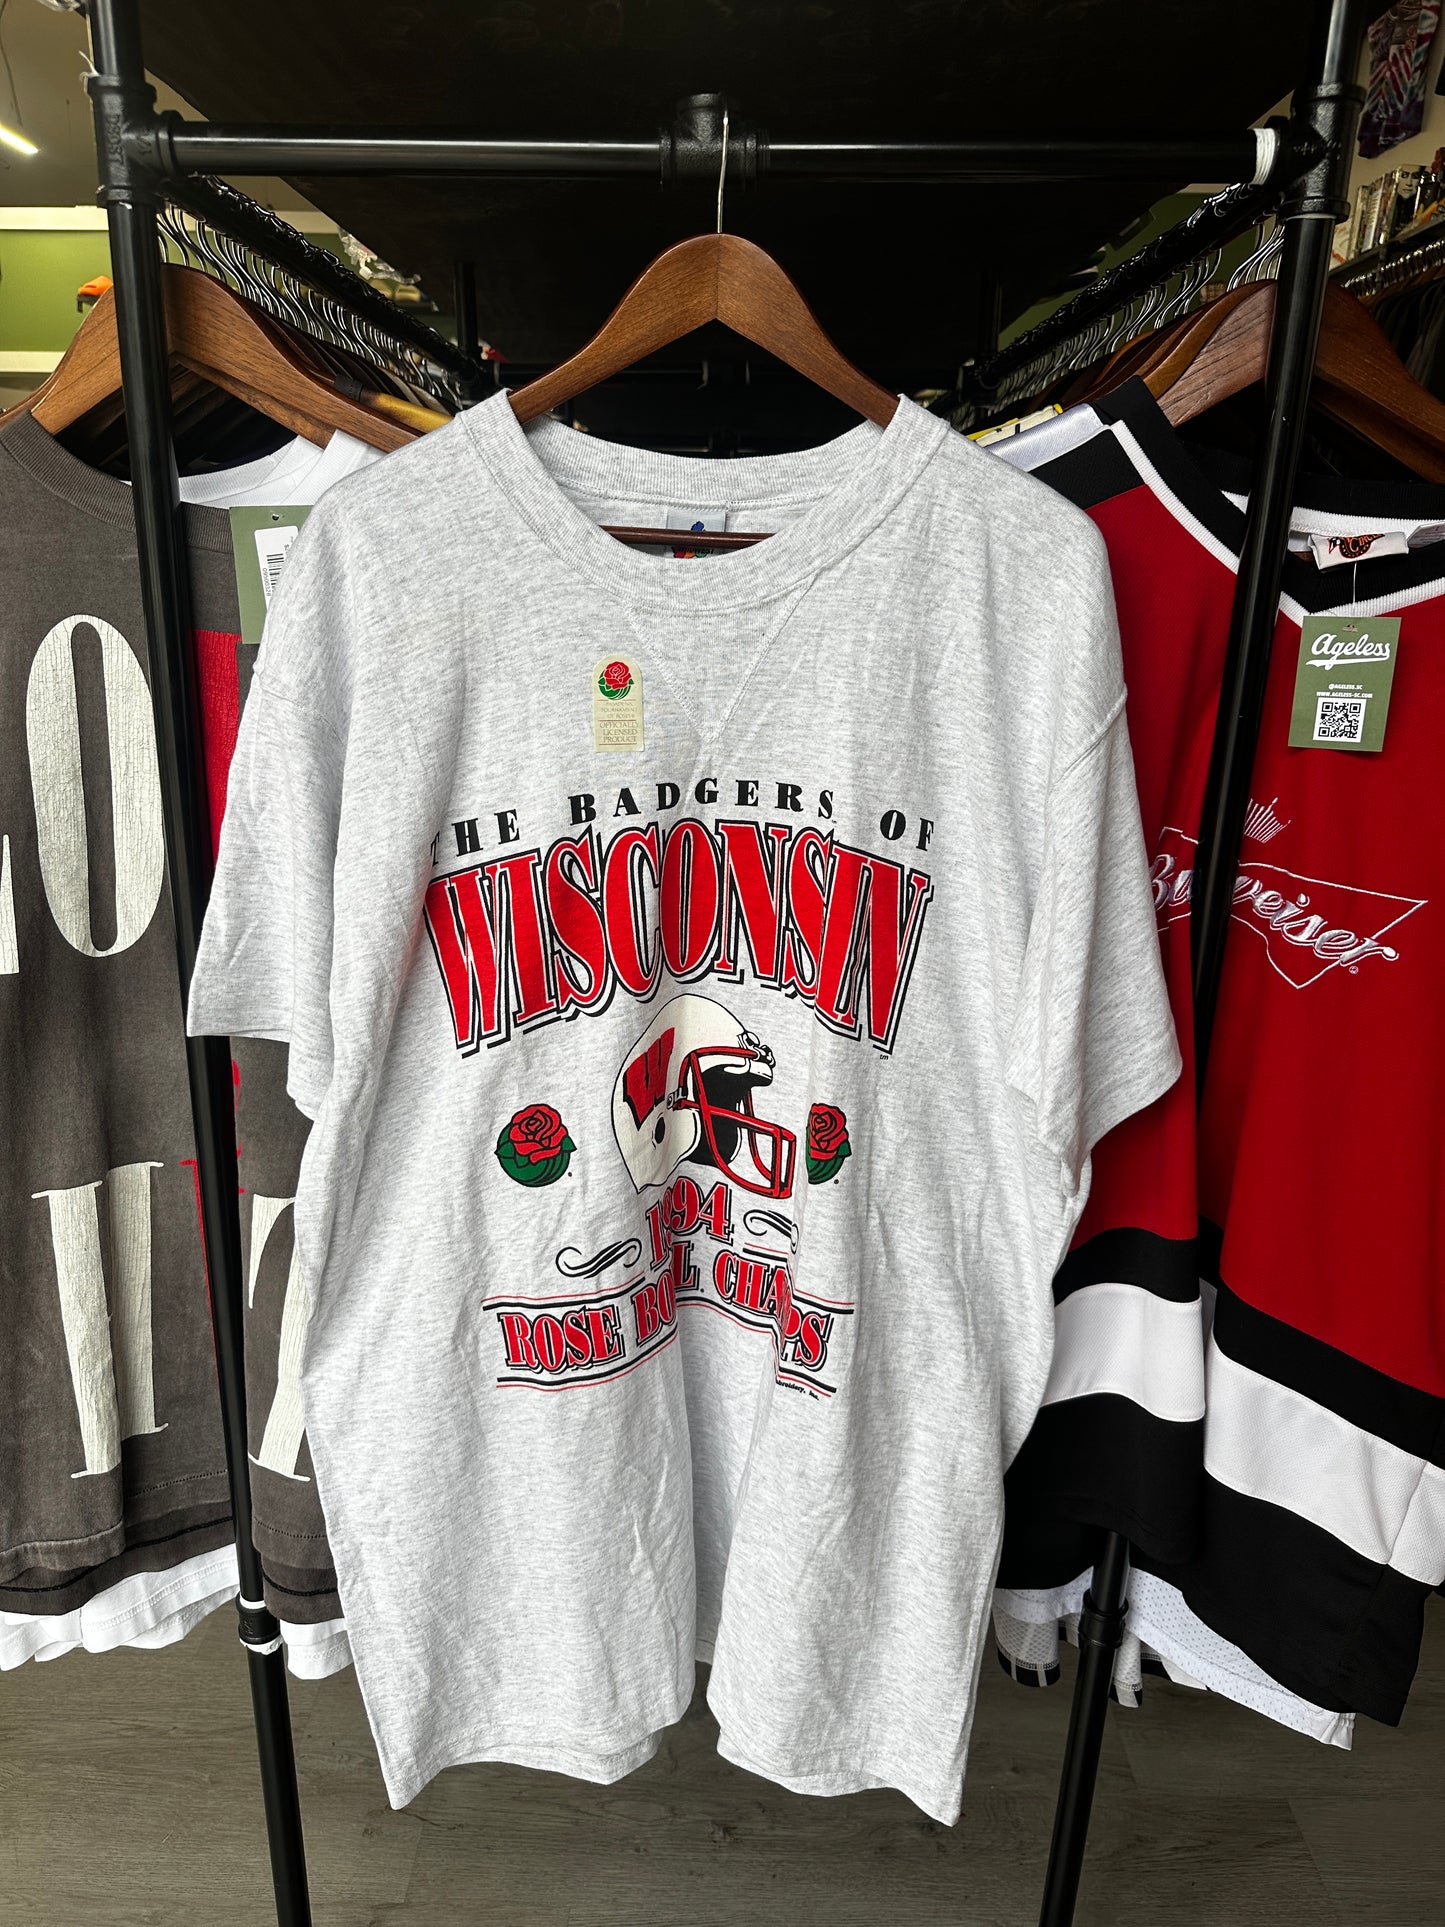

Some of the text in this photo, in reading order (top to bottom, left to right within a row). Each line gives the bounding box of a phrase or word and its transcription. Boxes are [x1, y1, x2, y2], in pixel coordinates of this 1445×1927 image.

[1305, 633, 1390, 671] Ageless
[430, 778, 935, 868] THE BADGERS OF
[423, 817, 935, 1055] WISCONSIN
[623, 1027, 675, 1131] W
[497, 1302, 624, 1373] ROSE
[630, 1241, 704, 1347] BOL
